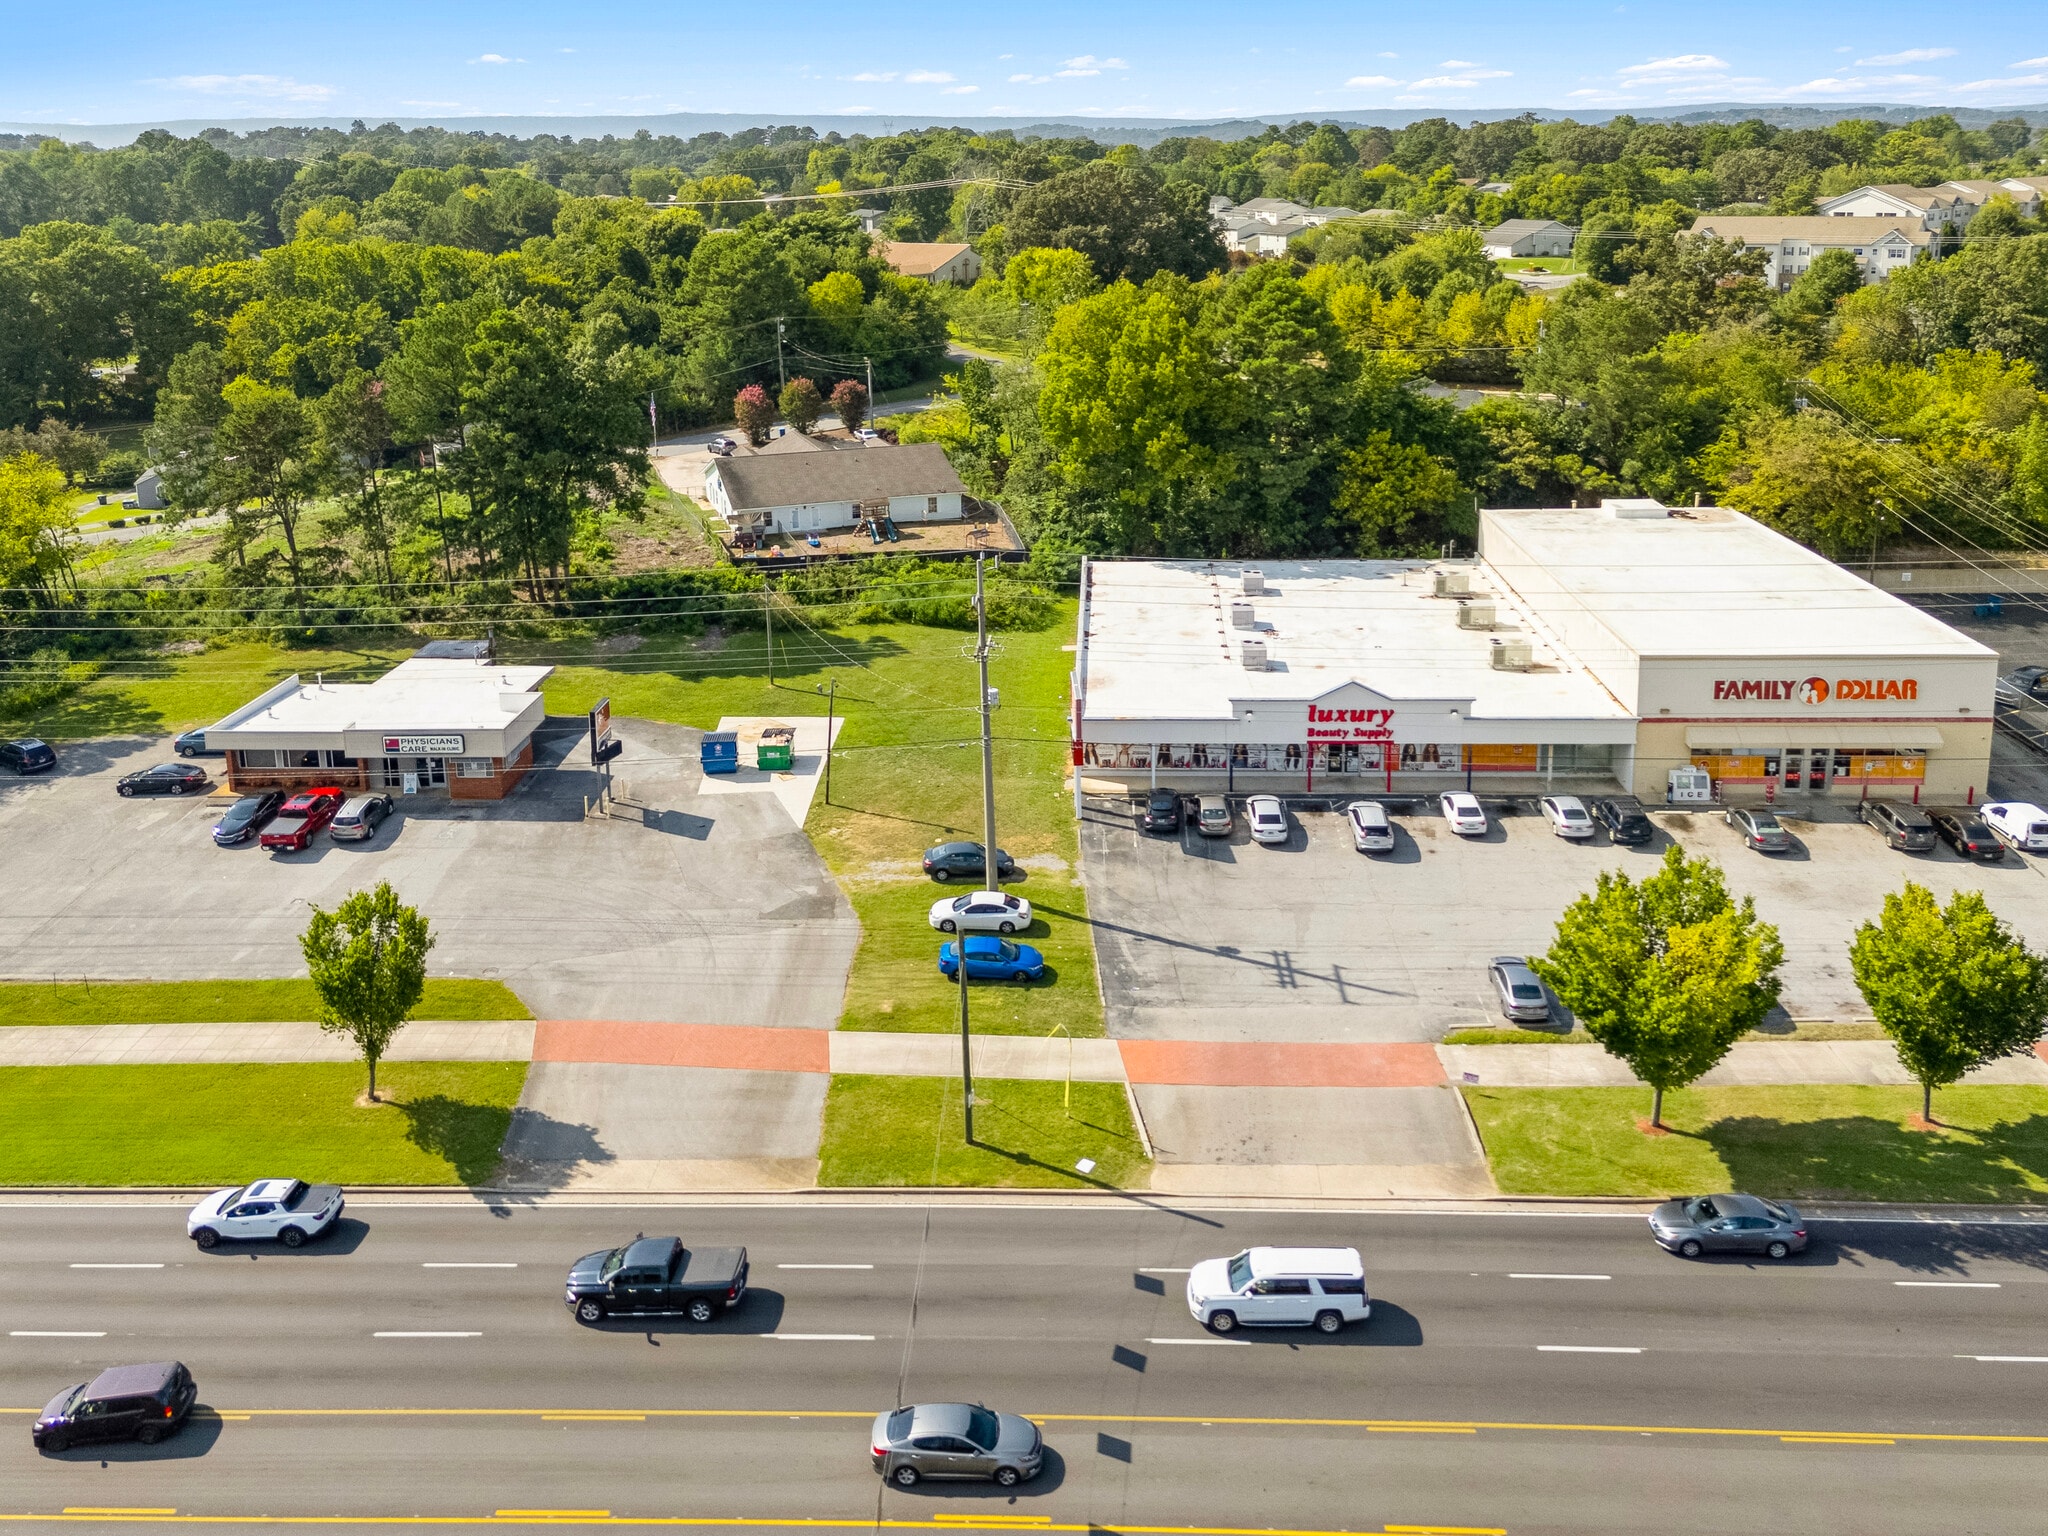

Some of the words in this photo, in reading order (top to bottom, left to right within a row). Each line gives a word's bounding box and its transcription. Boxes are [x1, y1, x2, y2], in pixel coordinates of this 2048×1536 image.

[1714, 680, 1797, 700] FAMILY
[1836, 679, 1918, 700] DOLLAR
[1308, 704, 1395, 727] luxury
[1307, 727, 1349, 739] Beauty
[1353, 727, 1394, 739] Supply
